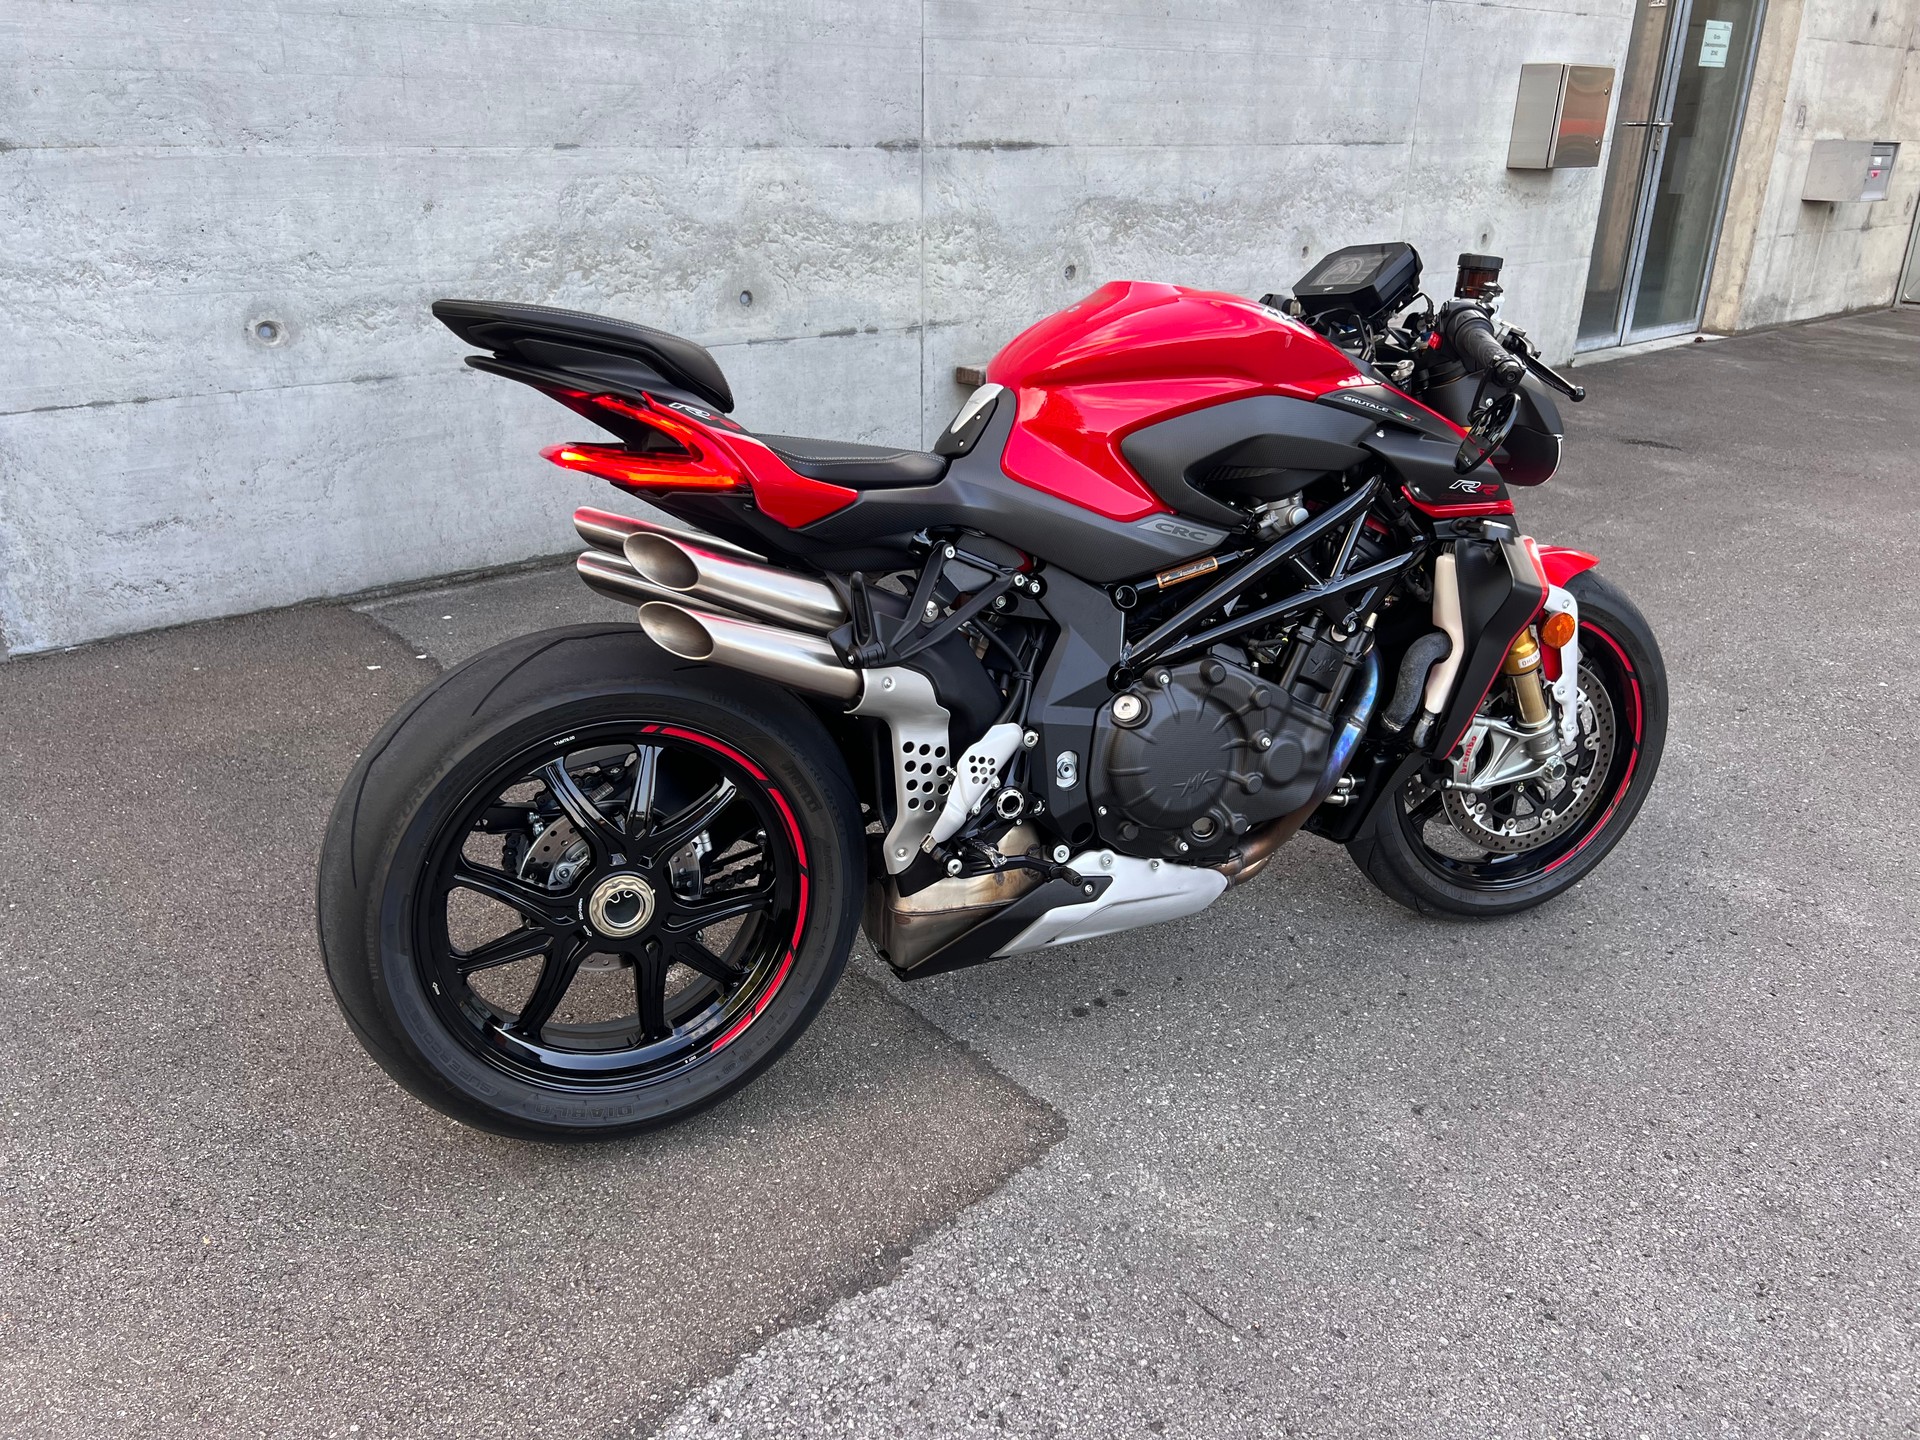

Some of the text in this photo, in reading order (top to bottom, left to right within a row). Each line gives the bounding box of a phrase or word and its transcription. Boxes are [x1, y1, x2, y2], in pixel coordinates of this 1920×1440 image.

[1343, 396, 1389, 413] BRUTALE
[1448, 479, 1500, 497] RR
[1155, 522, 1208, 541] CRC
[1459, 735, 1477, 774] brembo
